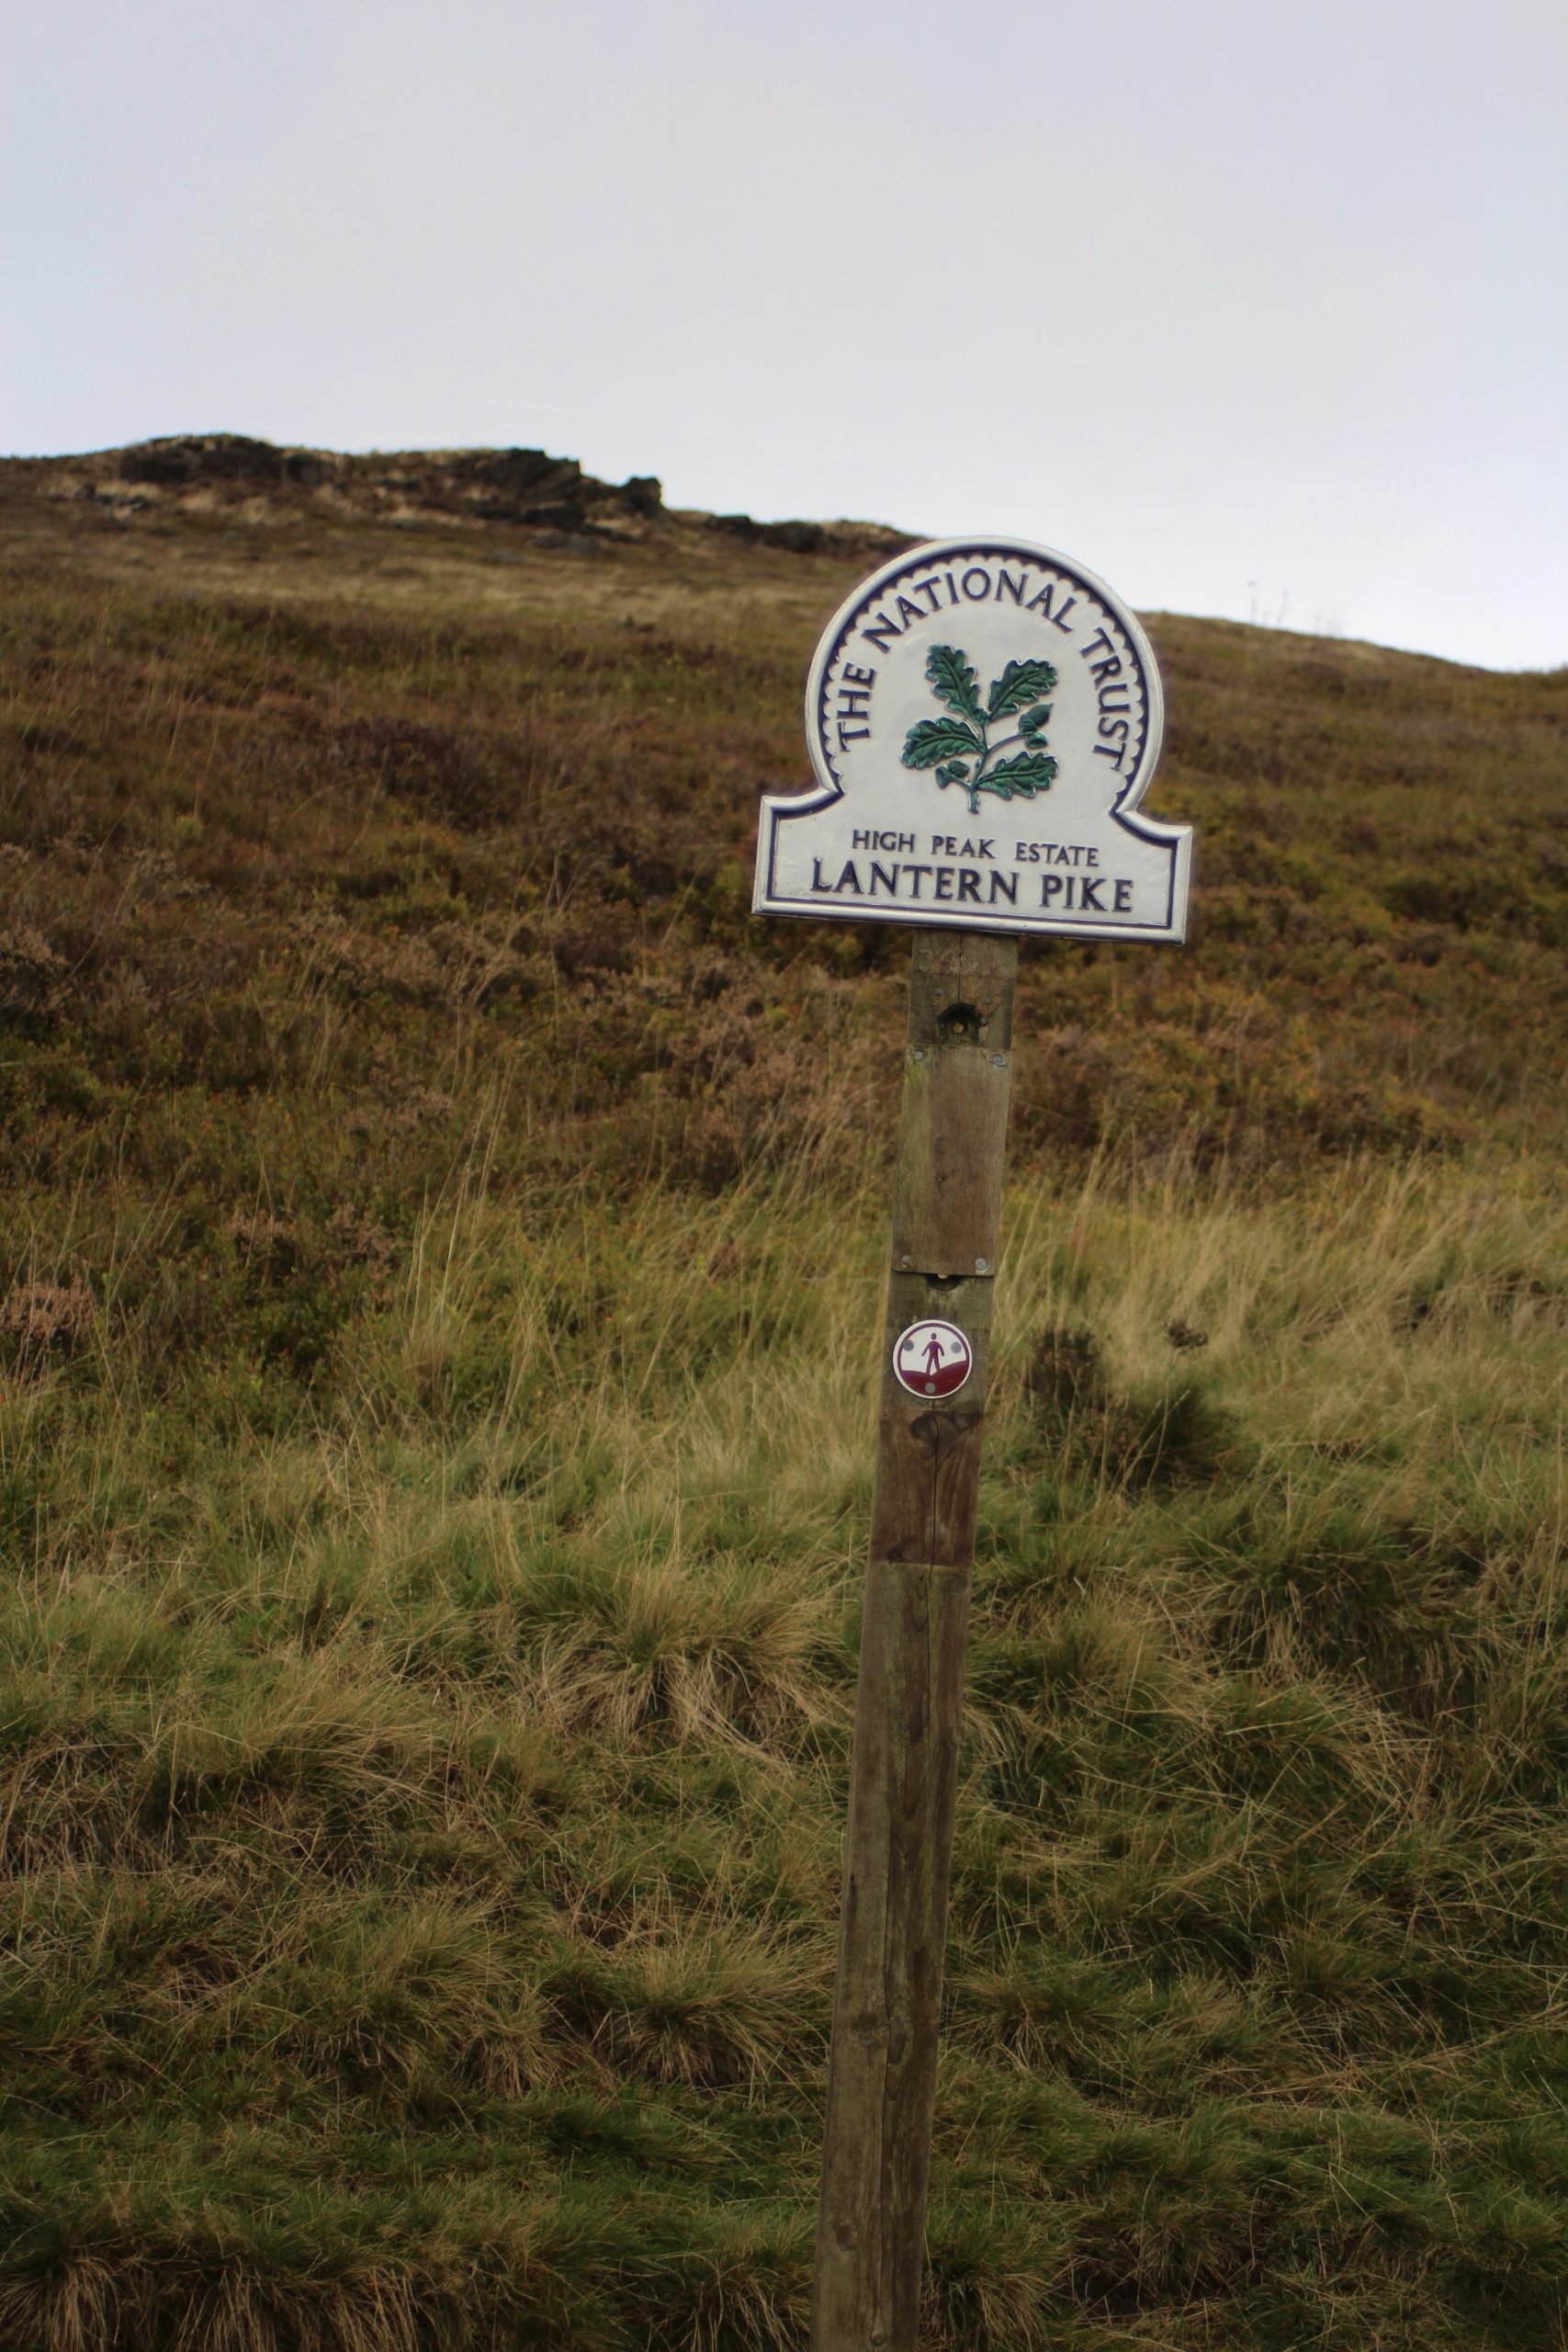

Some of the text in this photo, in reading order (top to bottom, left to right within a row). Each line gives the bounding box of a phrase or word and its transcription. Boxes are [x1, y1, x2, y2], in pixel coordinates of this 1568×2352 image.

[837, 568, 1131, 771] THE NATIONAL TRUST
[852, 830, 1099, 867] HIGH PEAK ESTATE
[811, 858, 1134, 912] LANTERN PIKE
